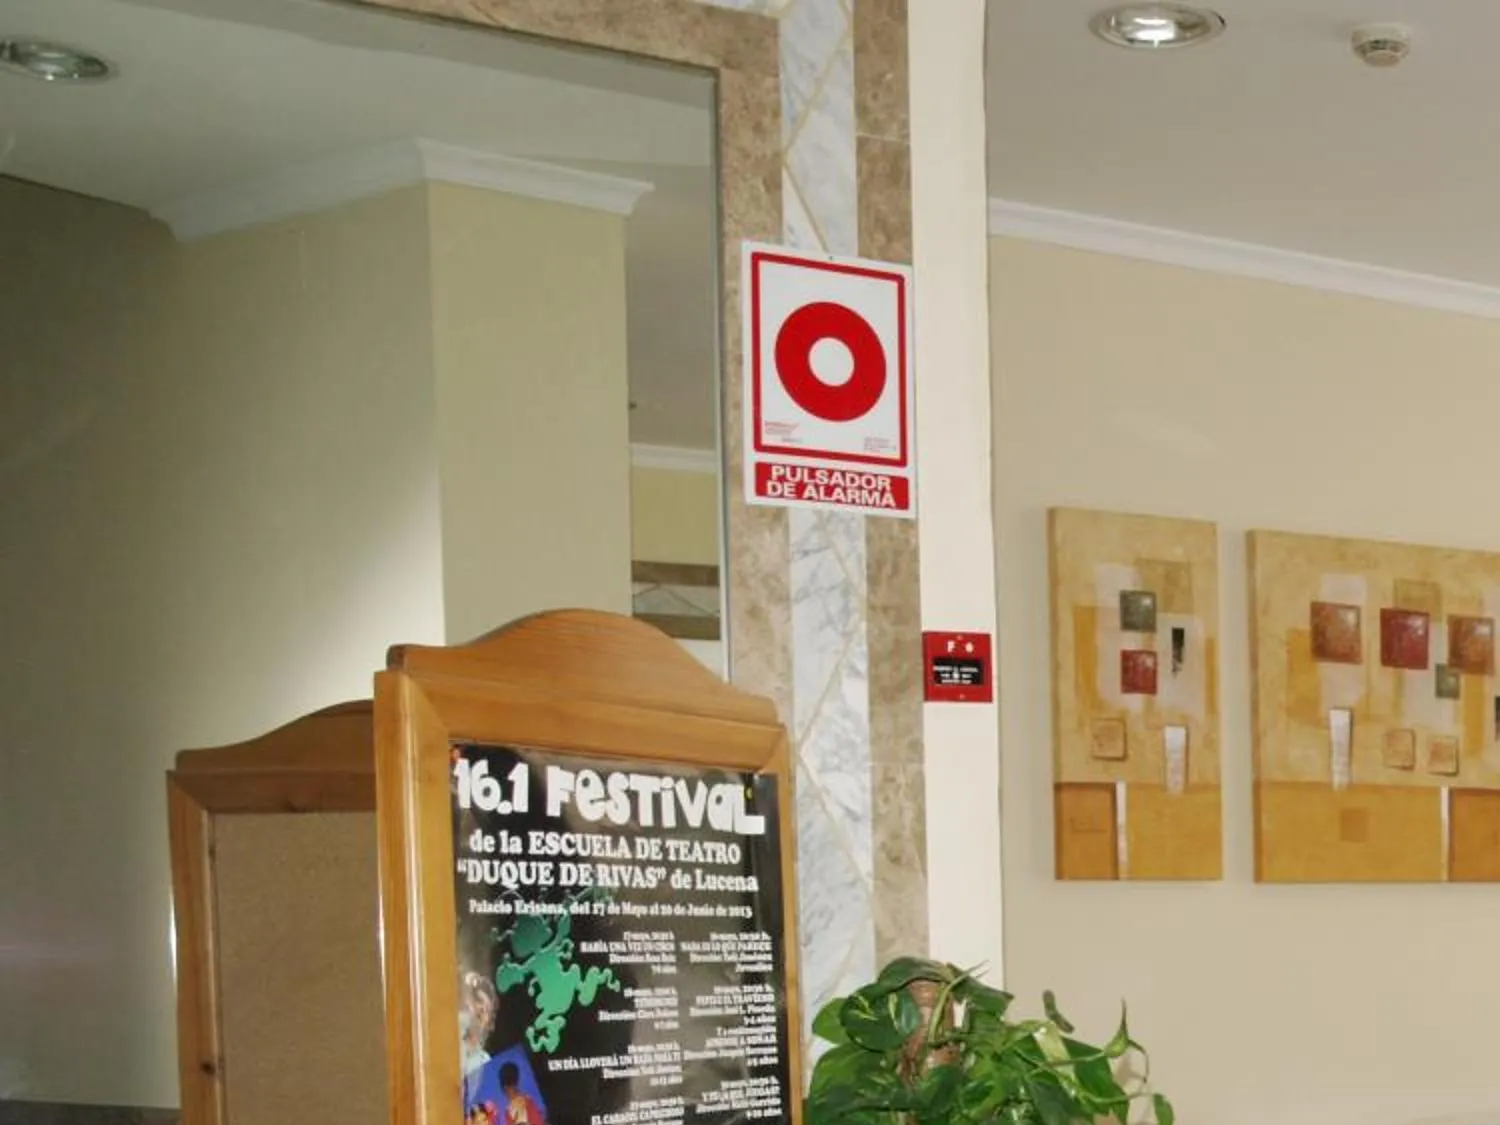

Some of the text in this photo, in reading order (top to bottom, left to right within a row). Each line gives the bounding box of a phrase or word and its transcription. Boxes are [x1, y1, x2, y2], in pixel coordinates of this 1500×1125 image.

[771, 465, 891, 491] PULSADOR
[767, 480, 896, 508] DE ALARMA
[453, 758, 529, 814] 16.1
[469, 829, 741, 864] de la ESCUELA DE TEATRO
[559, 863, 593, 887] DE
[670, 868, 693, 889] de
[695, 868, 759, 892] Lucena
[469, 899, 513, 914] Palacio
[570, 900, 590, 915] del
[607, 903, 621, 916] de
[622, 902, 648, 918] Mayo
